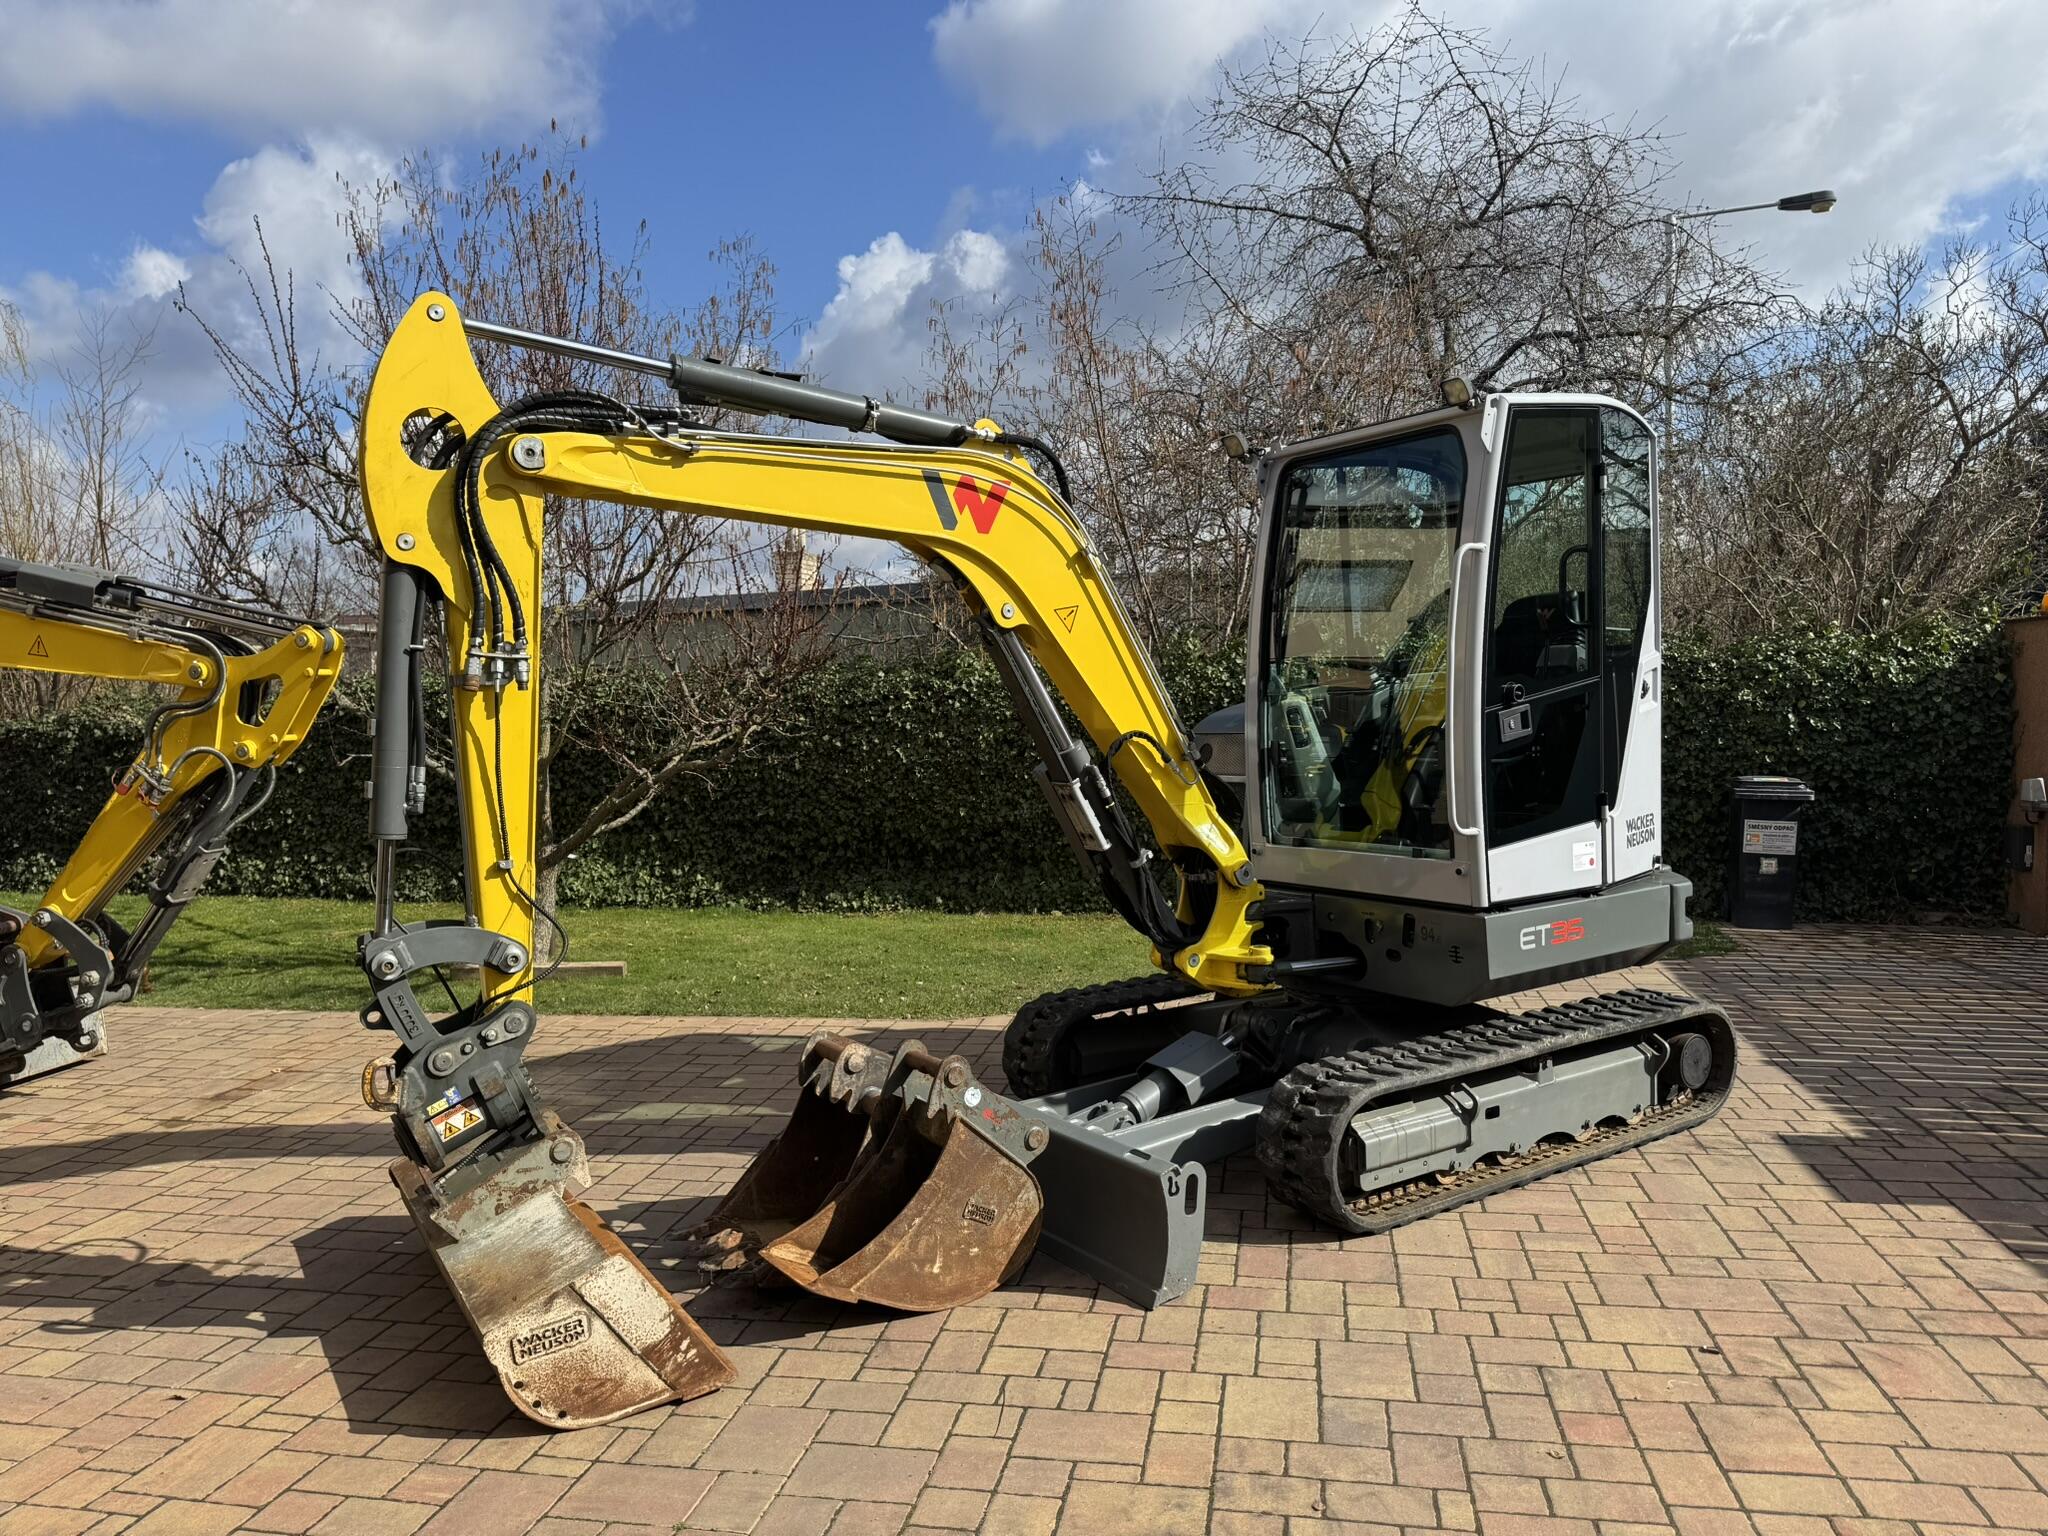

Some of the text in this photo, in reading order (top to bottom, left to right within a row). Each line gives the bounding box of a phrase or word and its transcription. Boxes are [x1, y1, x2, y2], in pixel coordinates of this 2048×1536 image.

[1626, 813, 1655, 833] WACKER
[1627, 827, 1655, 849] NEUSON
[1520, 917, 1585, 950] ET35
[516, 1318, 585, 1348] WACKER
[519, 1329, 585, 1359] NEUSON
